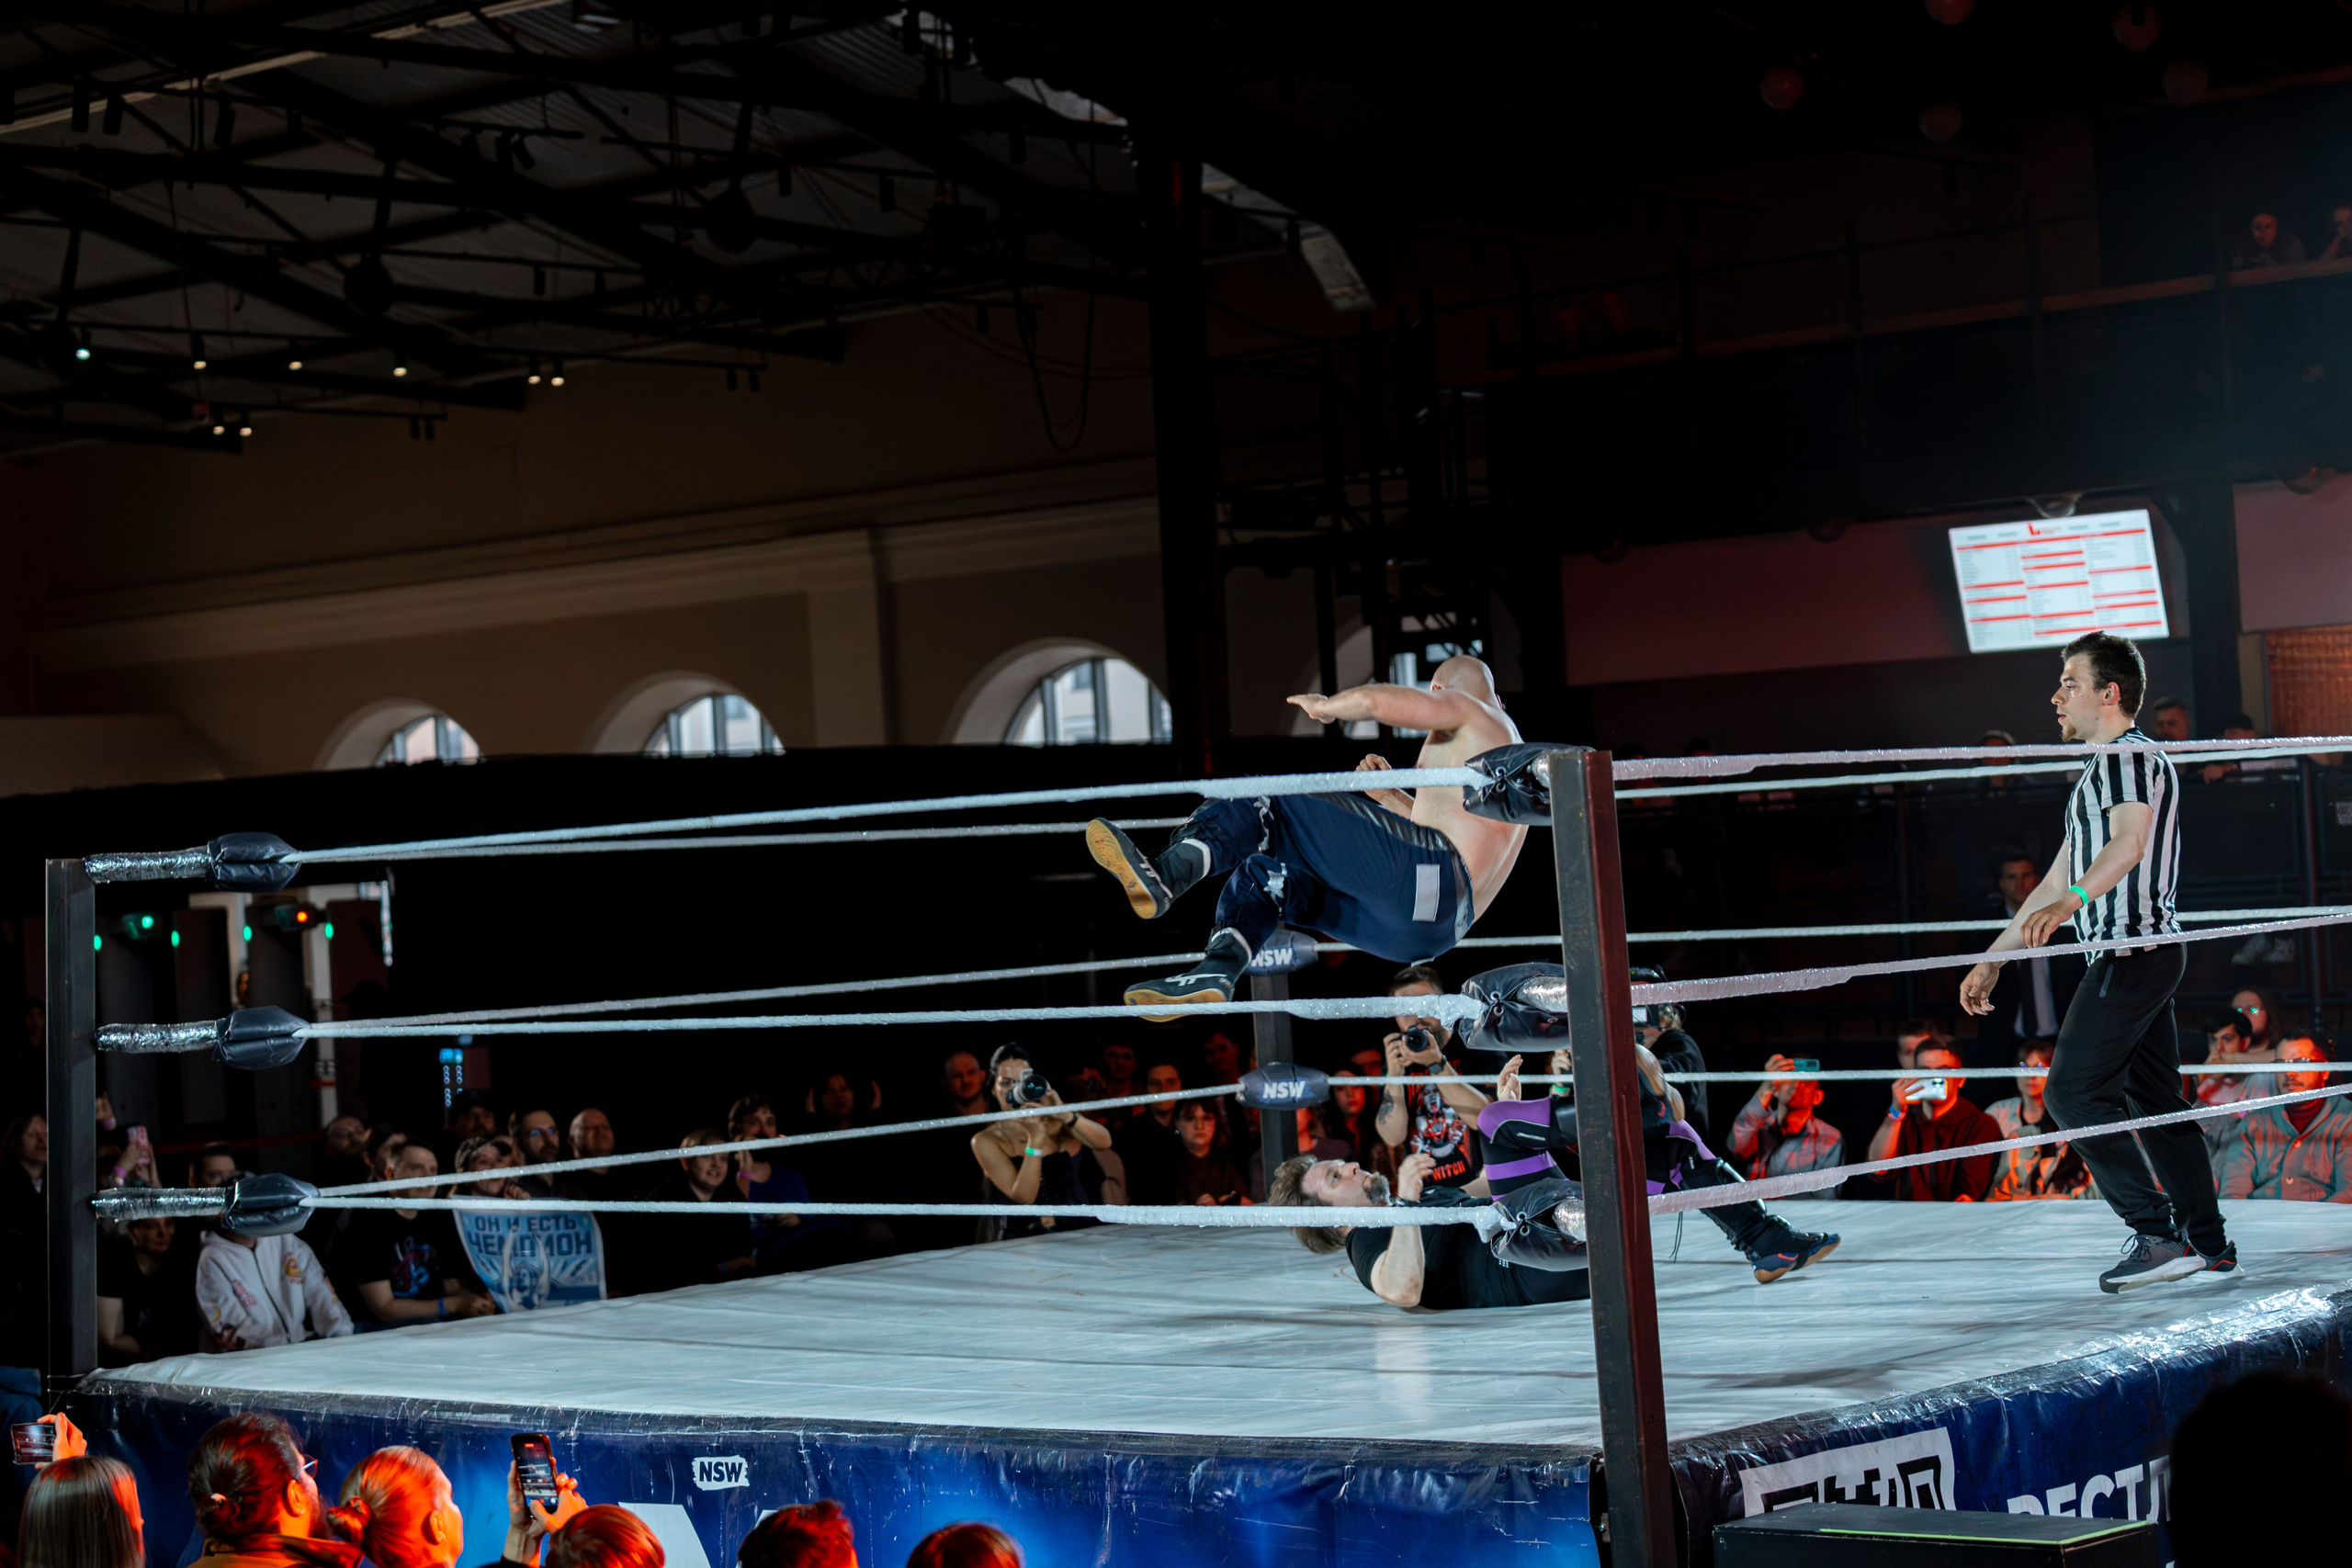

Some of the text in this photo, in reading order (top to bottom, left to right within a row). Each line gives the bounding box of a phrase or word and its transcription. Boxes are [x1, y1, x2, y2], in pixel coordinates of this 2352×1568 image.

[1250, 947, 1294, 967] NSW
[1262, 1080, 1306, 1100] NSW
[475, 1216, 501, 1232] ОН
[527, 1214, 577, 1232] ЕСТЬ
[699, 1461, 743, 1483] NSW
